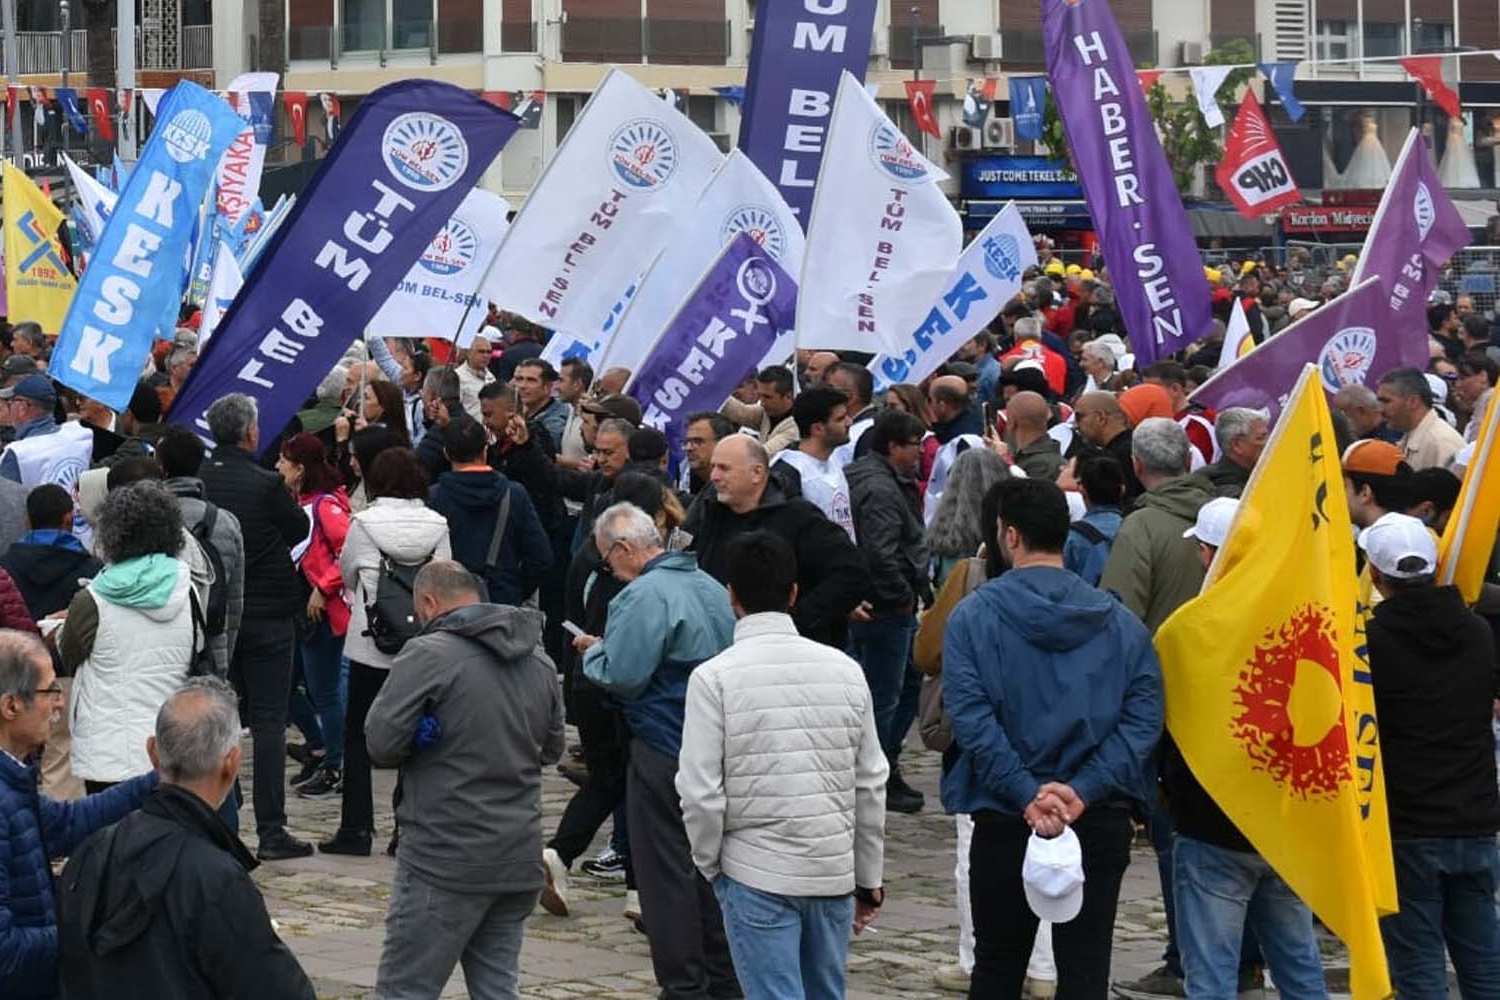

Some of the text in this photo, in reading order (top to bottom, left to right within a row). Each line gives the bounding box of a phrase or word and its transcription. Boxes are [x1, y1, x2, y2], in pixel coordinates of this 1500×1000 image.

[162, 123, 212, 161] KESK
[978, 169, 1001, 183] JUST
[1003, 169, 1028, 182] COME
[1028, 169, 1055, 182] TEKEL
[590, 189, 628, 230] TÜM
[881, 188, 908, 232] TÜM
[1291, 212, 1328, 225] Kordon
[315, 179, 417, 292] TÜM
[70, 170, 183, 385] KESK
[982, 237, 1021, 282] KESK
[421, 286, 483, 309] BEL-SEN
